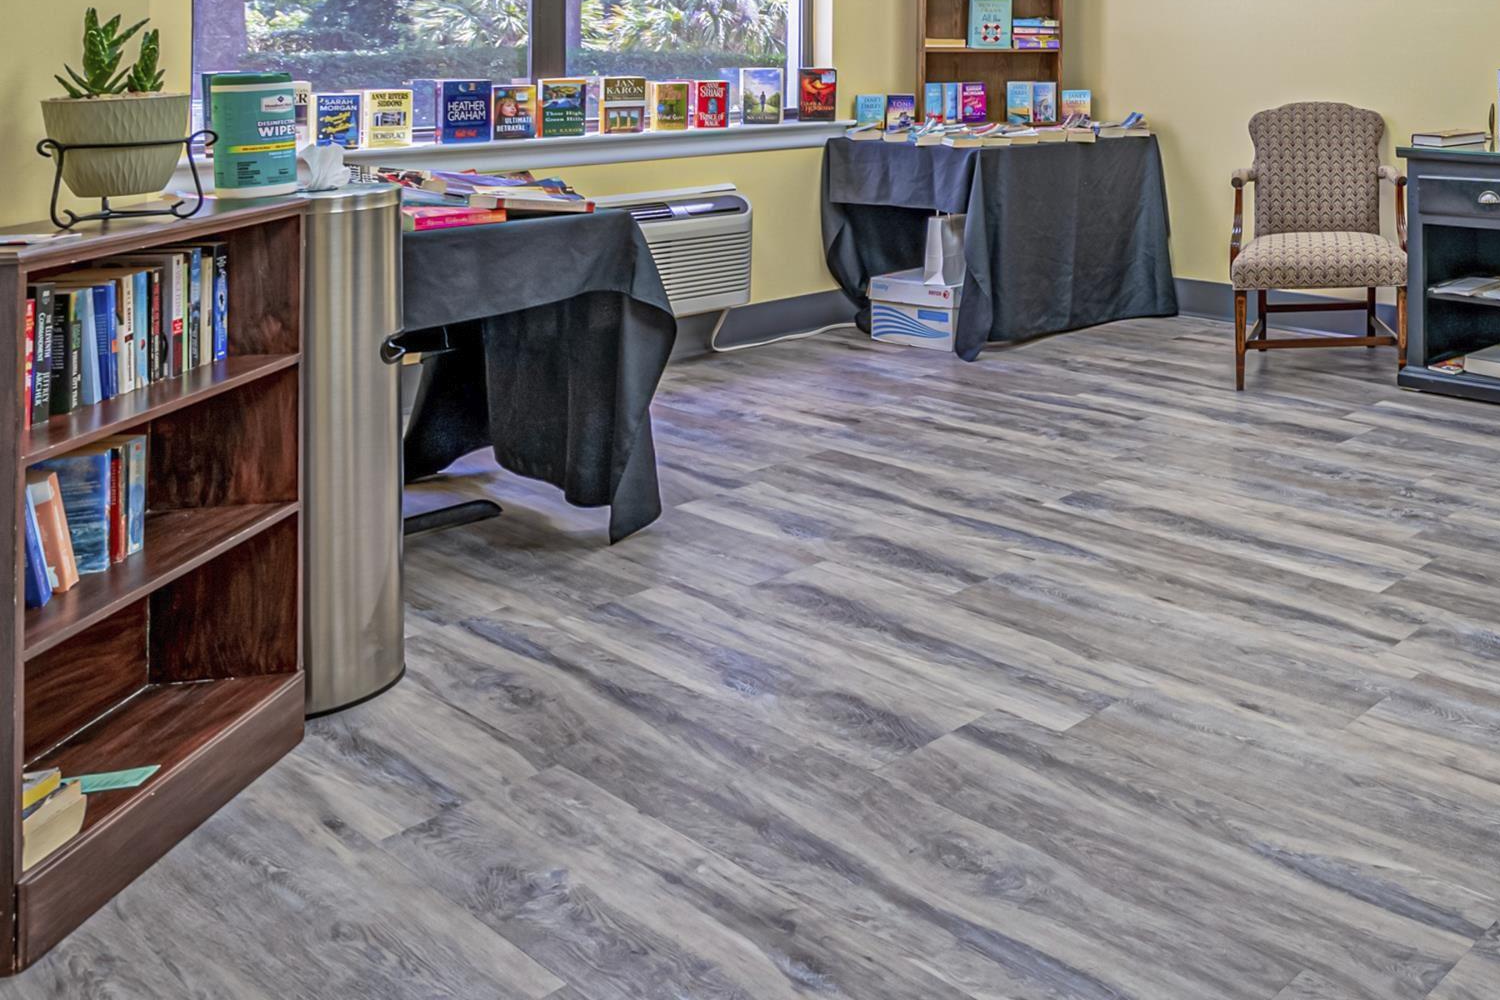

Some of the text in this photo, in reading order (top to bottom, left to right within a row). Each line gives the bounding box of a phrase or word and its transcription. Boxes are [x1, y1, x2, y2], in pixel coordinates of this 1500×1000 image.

[615, 79, 635, 87] JAN
[387, 92, 408, 100] RIVERS
[606, 86, 644, 95] KARON
[700, 85, 725, 98] STUART
[447, 100, 485, 111] HEATHER
[447, 110, 486, 121] GRAHAM
[258, 123, 296, 137] WIPES
[496, 124, 526, 132] BETRAYAL
[36, 312, 46, 362] COMMANDMENT
[43, 325, 53, 358] ELEVENTH
[34, 371, 43, 407] ARCHER
[41, 371, 51, 403] JEFFREY
